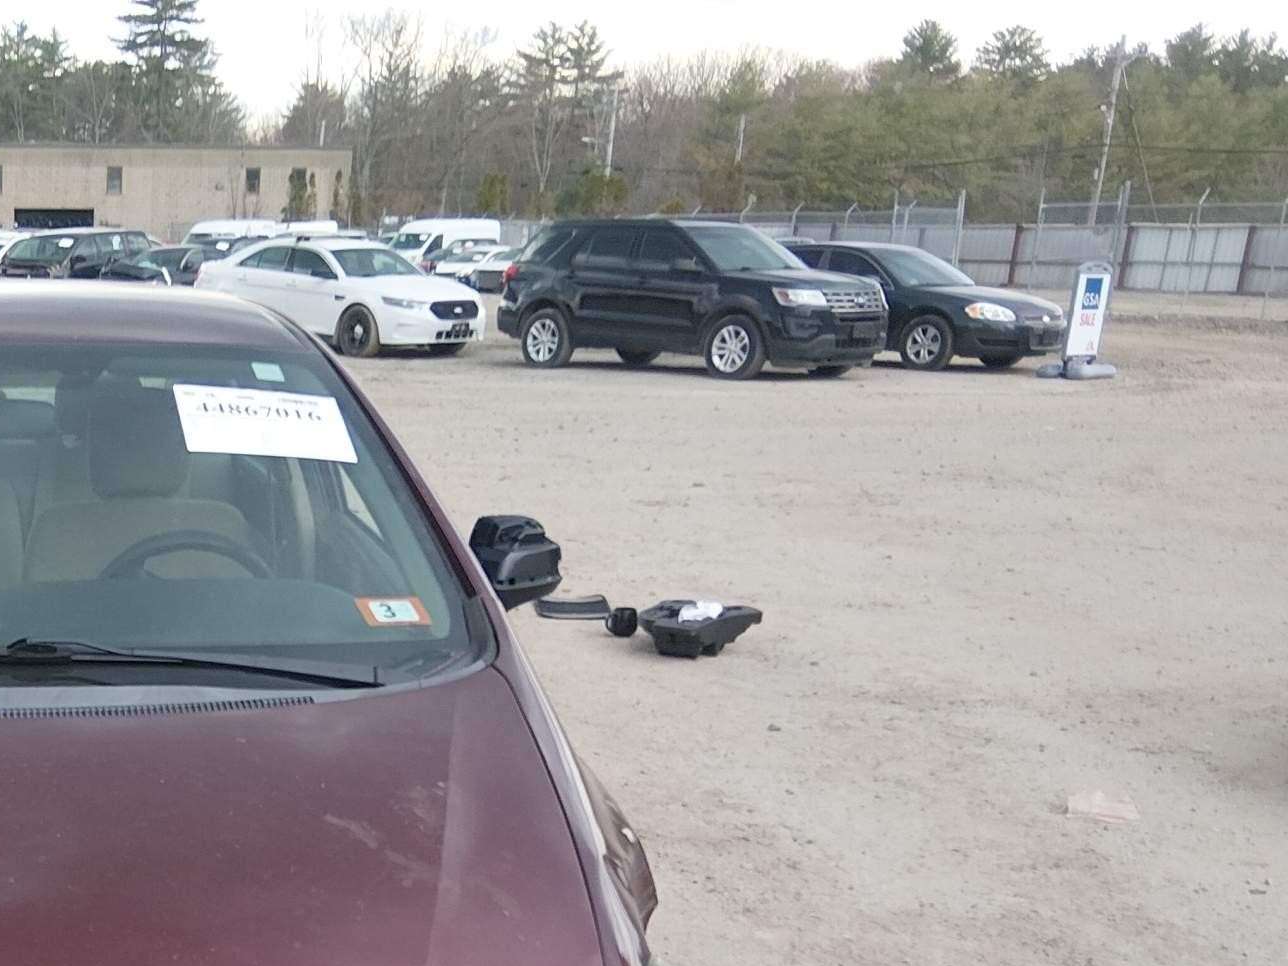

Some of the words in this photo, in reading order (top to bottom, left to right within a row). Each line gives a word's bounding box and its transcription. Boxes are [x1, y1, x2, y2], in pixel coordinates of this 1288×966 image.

[1083, 292, 1100, 307] GSA
[1079, 311, 1097, 327] SALE
[379, 603, 397, 618] 3
